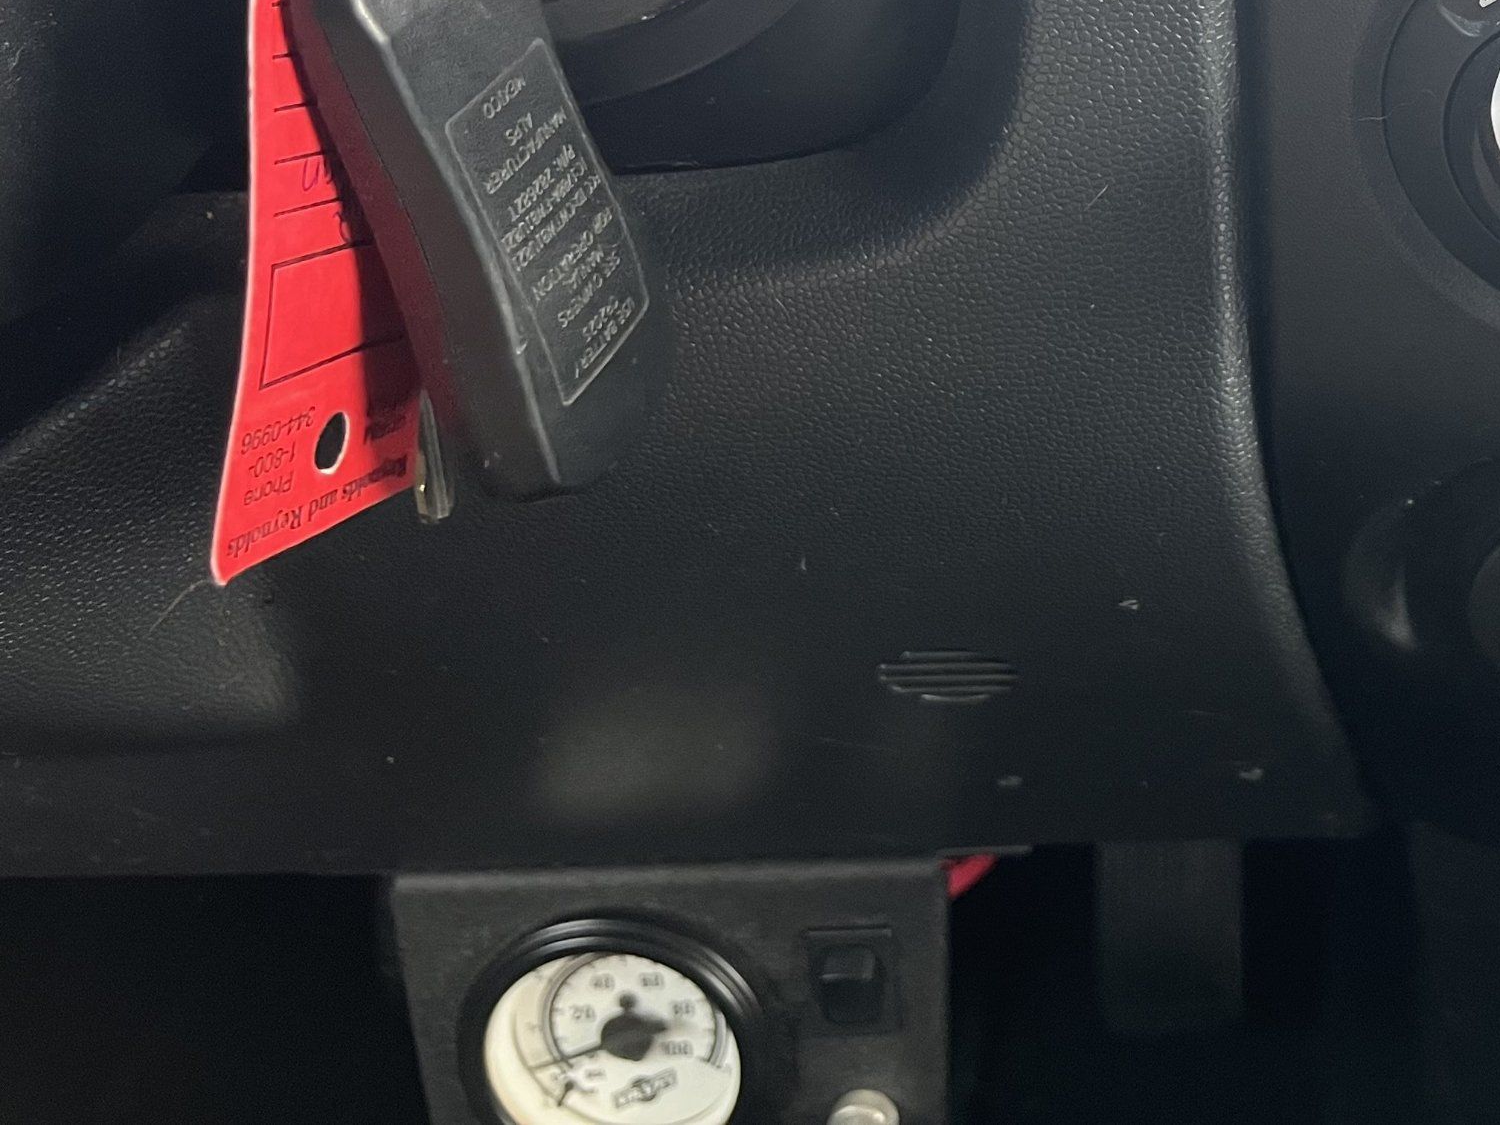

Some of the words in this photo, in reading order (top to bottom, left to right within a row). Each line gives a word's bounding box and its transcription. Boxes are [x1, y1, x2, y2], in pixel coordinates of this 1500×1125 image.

[484, 108, 568, 196] MANUFACTURER
[240, 406, 316, 455] 344-0996
[248, 441, 295, 478] 1-800-
[243, 472, 294, 506] Phone
[308, 488, 338, 518] and
[226, 505, 303, 558] Reynolds
